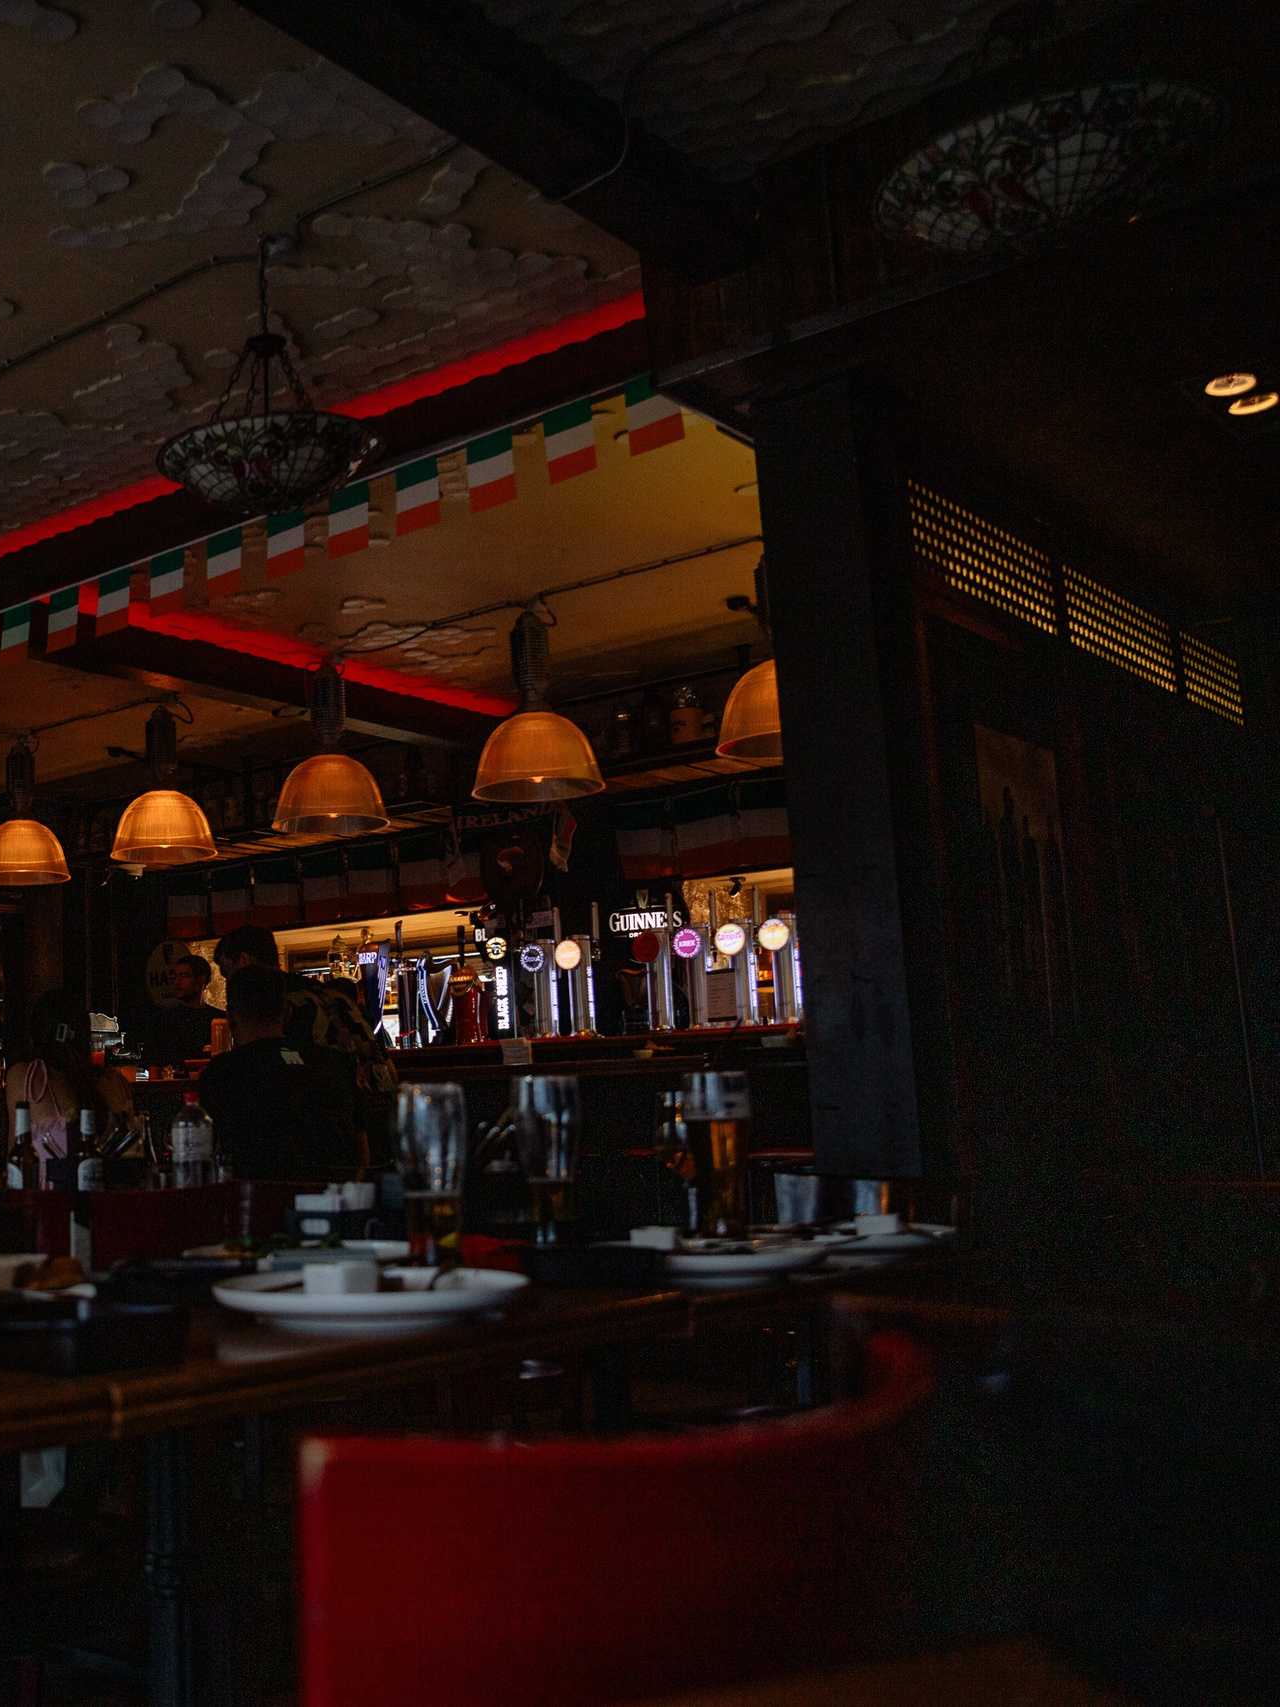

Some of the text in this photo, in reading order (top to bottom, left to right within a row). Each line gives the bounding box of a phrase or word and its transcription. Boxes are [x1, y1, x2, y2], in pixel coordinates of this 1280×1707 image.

[456, 800, 555, 829] IRELAND
[679, 939, 697, 948] KRIEK
[495, 966, 510, 1029] BLACK SHEEP
